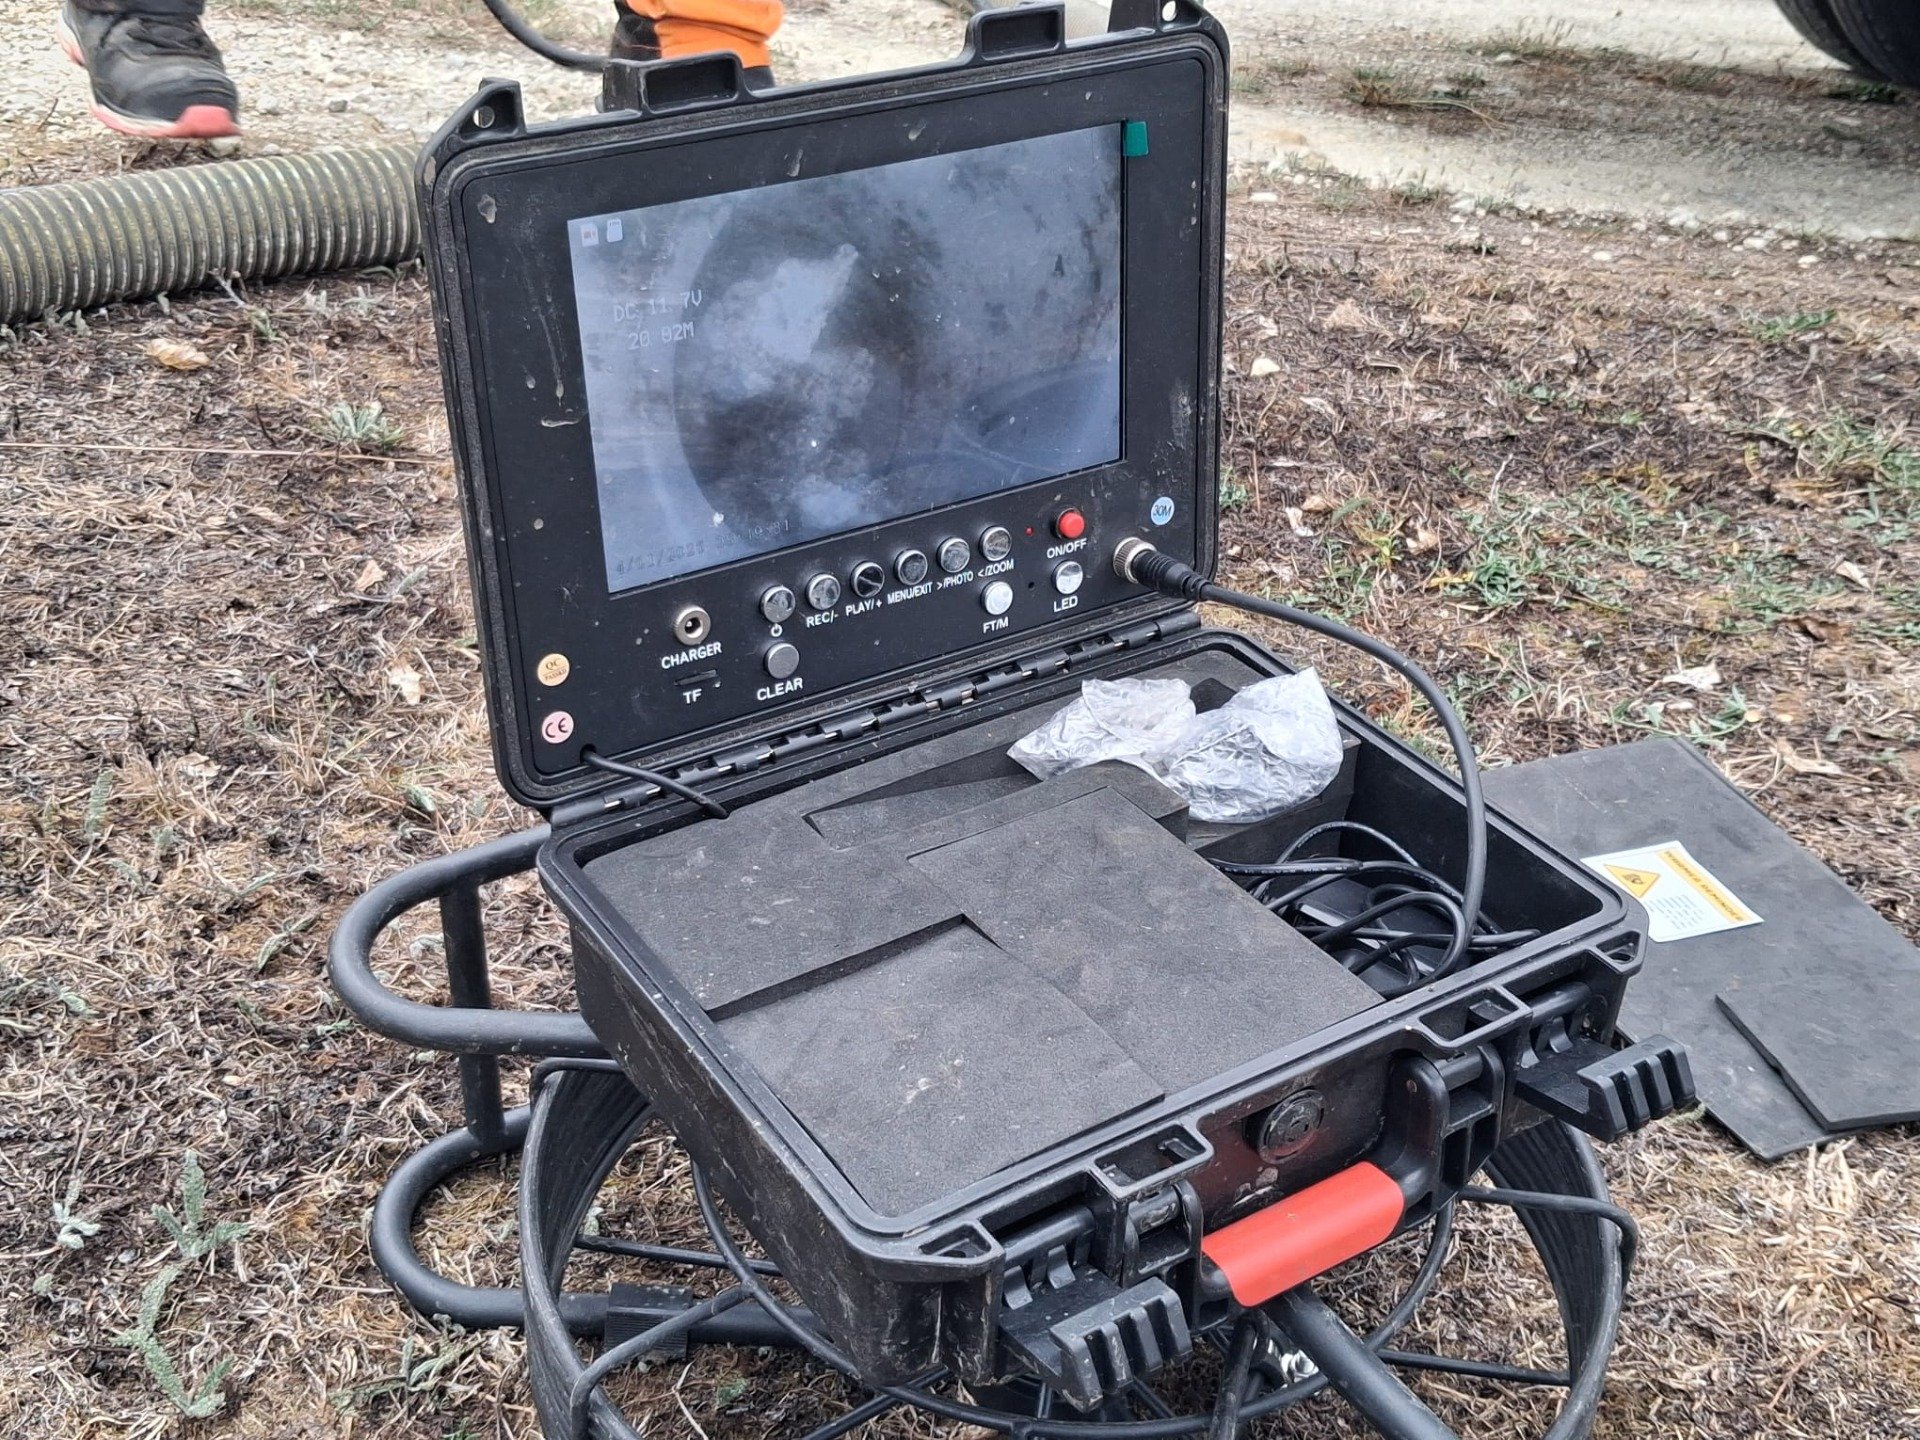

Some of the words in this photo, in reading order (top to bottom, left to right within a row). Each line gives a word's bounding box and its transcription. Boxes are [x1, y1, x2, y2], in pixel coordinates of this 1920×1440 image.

[1047, 538, 1087, 559] ON/OFF
[806, 610, 839, 628] REC/-
[887, 581, 933, 605] MENU/EXIT
[1053, 595, 1079, 612] LED
[983, 616, 1010, 634] FT/M
[545, 657, 561, 670] QC
[661, 641, 722, 669] CHARGER
[683, 689, 702, 704] TF
[757, 677, 803, 701] CLEAR
